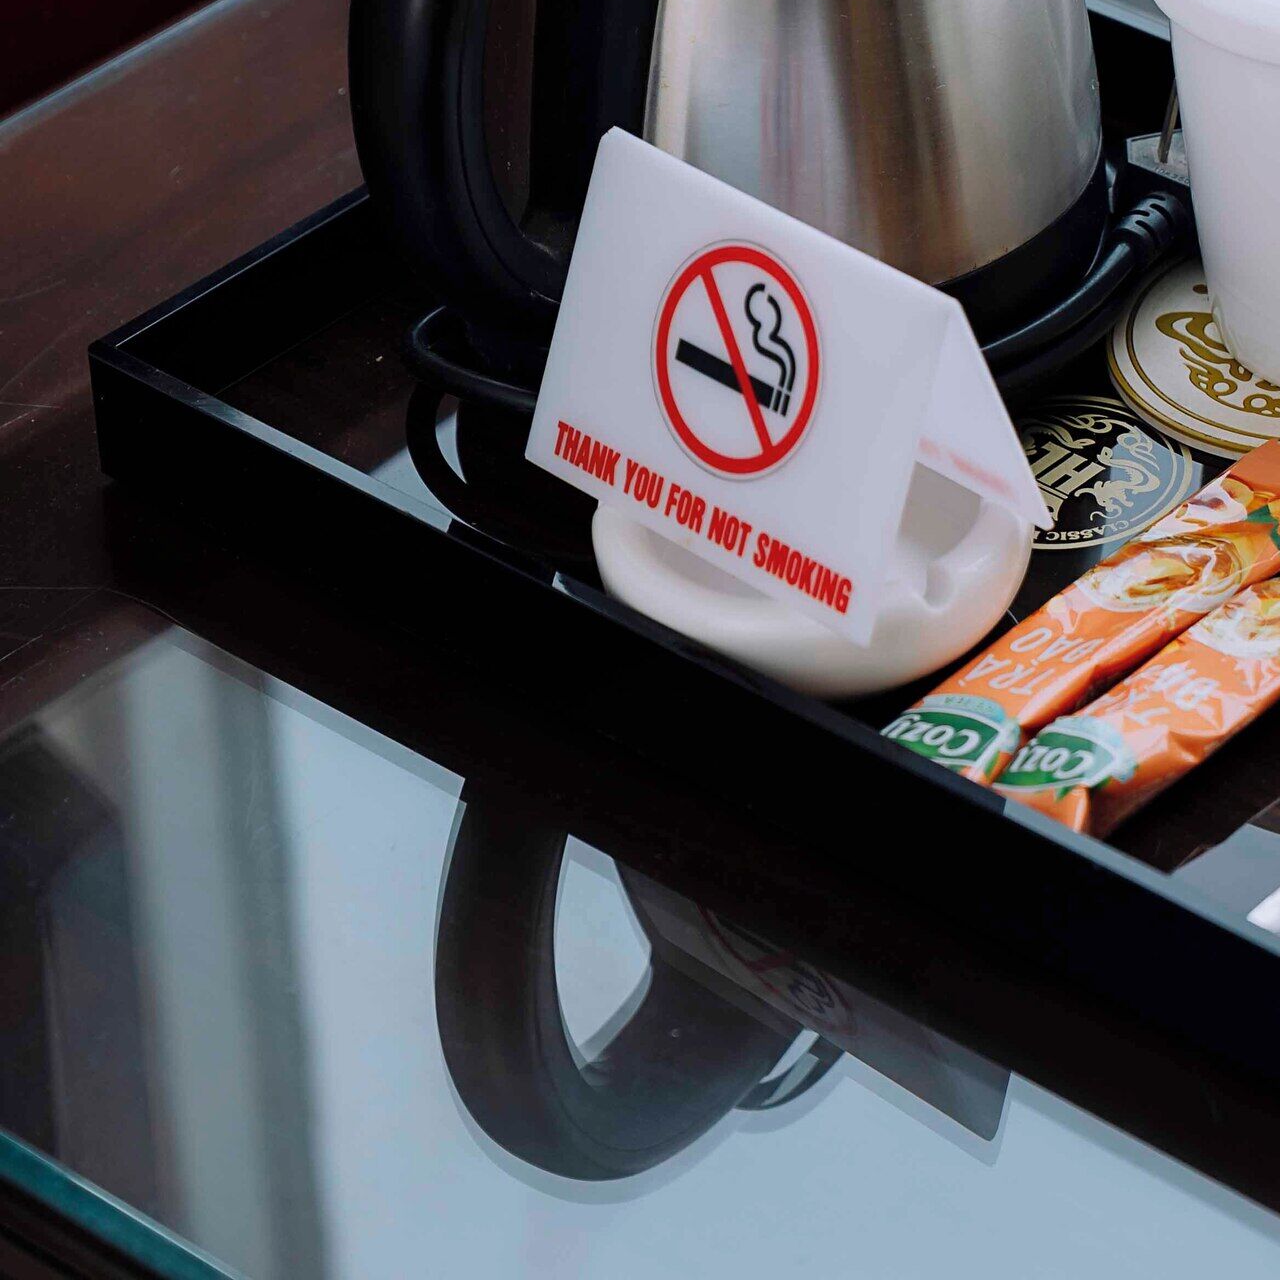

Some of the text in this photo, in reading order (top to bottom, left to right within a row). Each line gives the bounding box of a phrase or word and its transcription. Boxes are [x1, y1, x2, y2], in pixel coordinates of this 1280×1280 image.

[555, 422, 853, 615] THANK YOU FOR NOT SMOKING
[1045, 520, 1130, 541] CLASSIC
